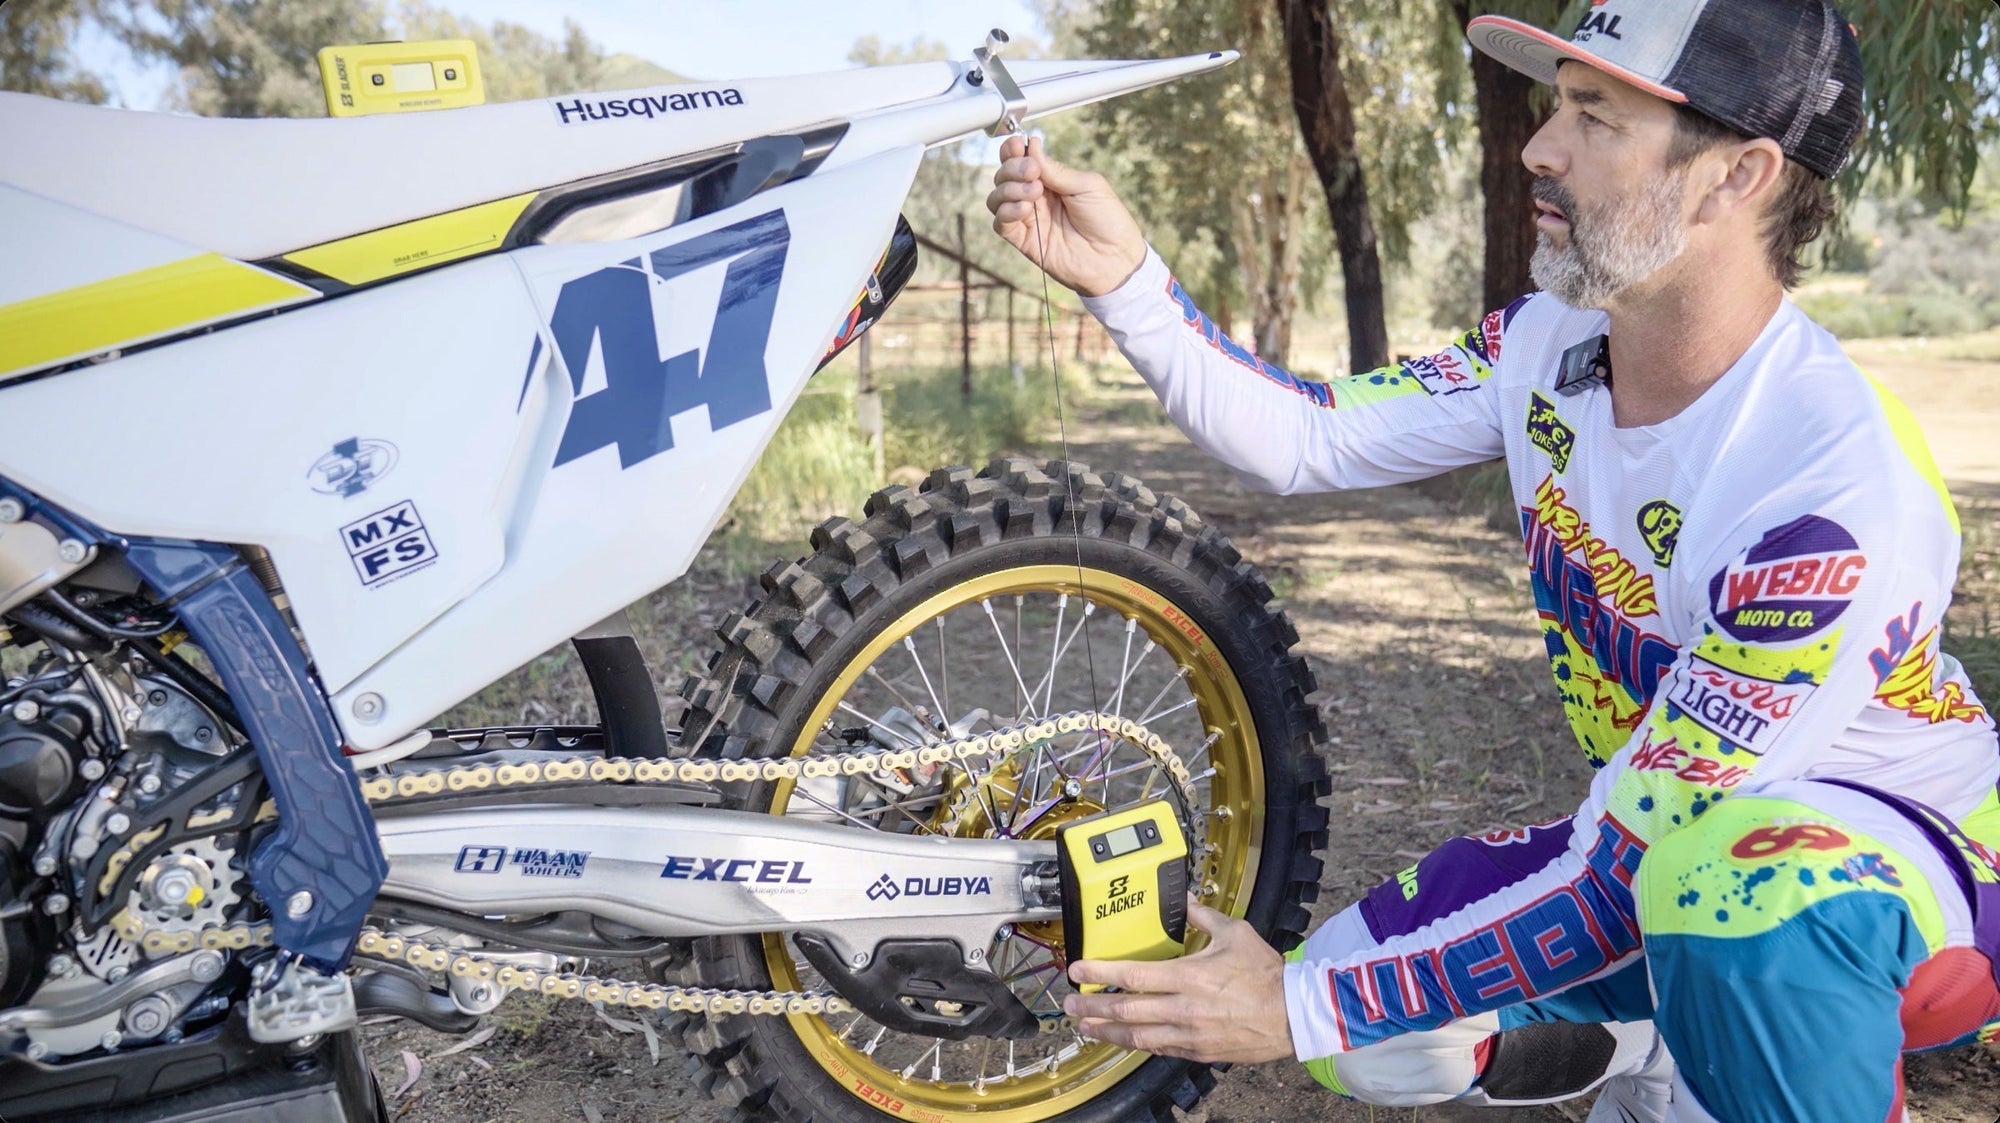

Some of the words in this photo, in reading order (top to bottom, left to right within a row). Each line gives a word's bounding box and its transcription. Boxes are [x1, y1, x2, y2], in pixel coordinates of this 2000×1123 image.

[556, 88, 744, 123] Husqvarna
[517, 207, 791, 470] 47
[349, 508, 416, 549] MX
[361, 536, 426, 577] FS
[1727, 555, 1868, 610] WEBIG
[1162, 605, 1206, 646] EXCEL
[1734, 609, 1786, 627] MOTO
[1786, 610, 1816, 627] CO.
[1681, 678, 1769, 744] LIGHT
[1629, 727, 1689, 772] WE
[513, 849, 590, 868] HAAN
[523, 865, 582, 877] WHEELS
[661, 855, 813, 884] EXCEL
[904, 876, 992, 896] DUBYA
[1095, 891, 1144, 920] SLACKER
[855, 1079, 905, 1114] EXCEL
